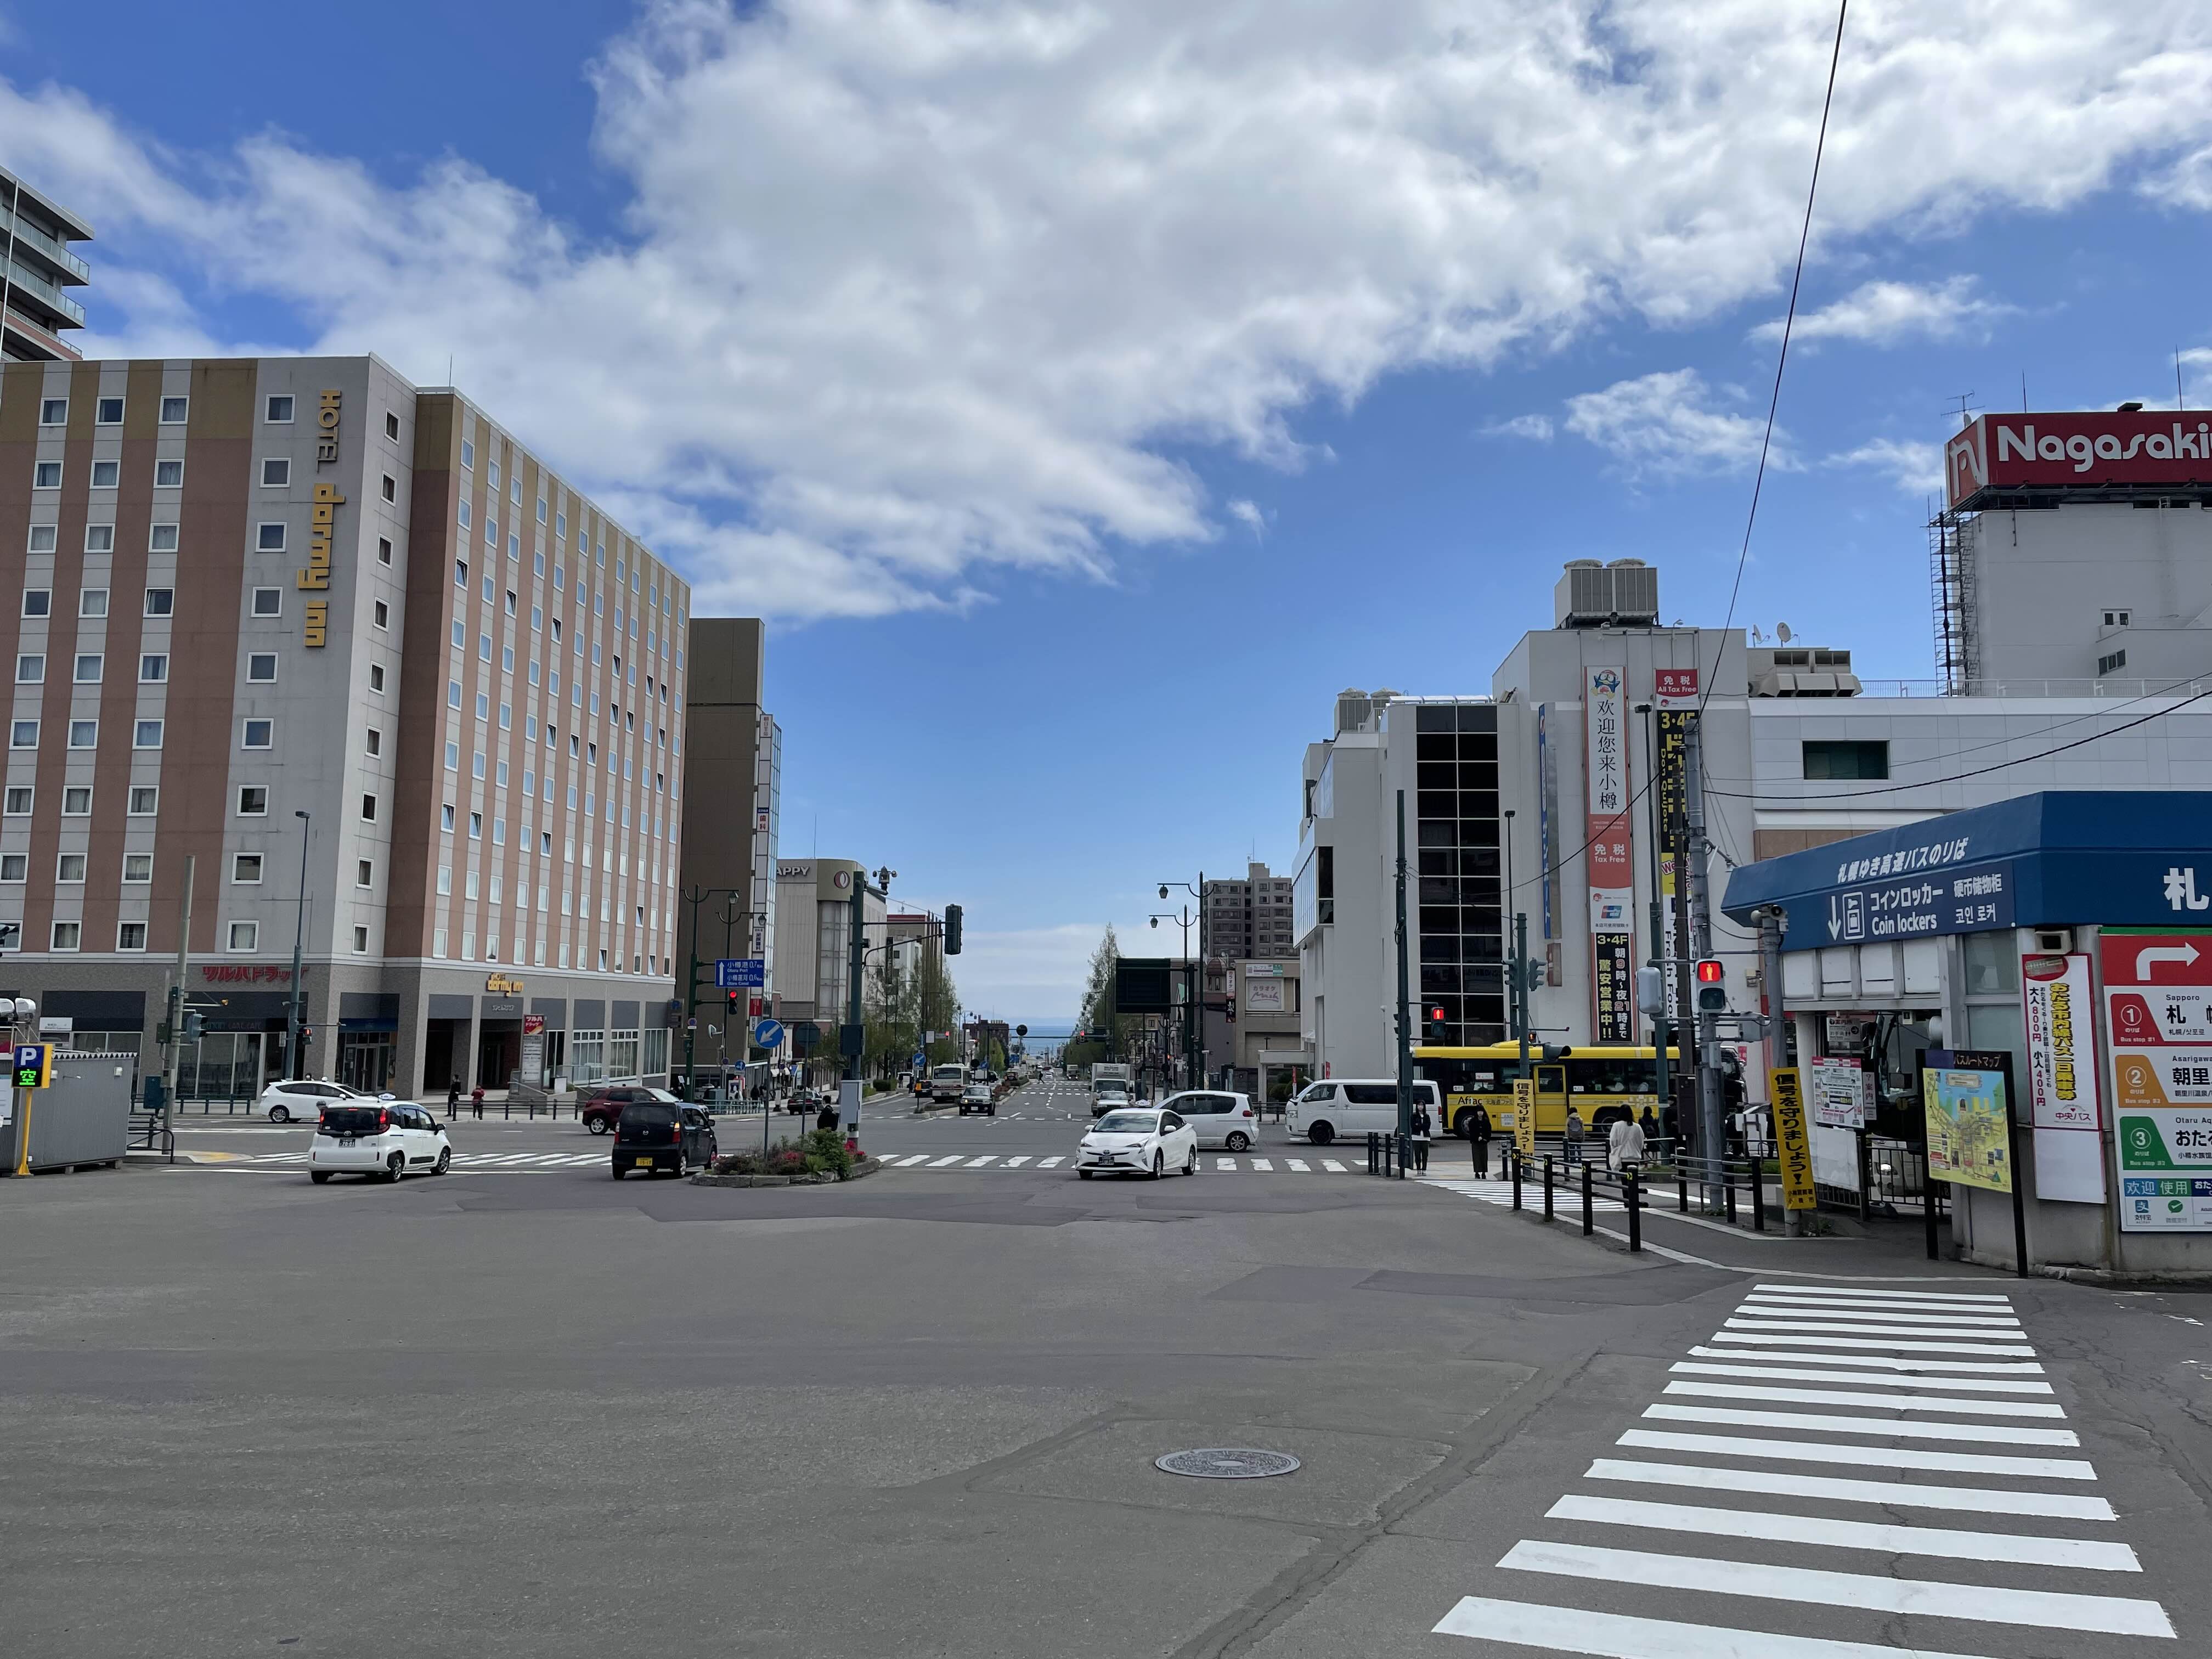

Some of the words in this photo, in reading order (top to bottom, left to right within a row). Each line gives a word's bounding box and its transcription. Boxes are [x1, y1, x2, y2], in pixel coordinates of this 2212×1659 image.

[317, 390, 341, 474] HOTEL
[1997, 422, 2212, 472] Nagasaki
[297, 483, 346, 590] dormy
[303, 600, 327, 647] inn
[1663, 675, 1690, 685] 免税
[1597, 699, 1617, 809] 欢迎您来小樽
[1594, 844, 1625, 855] 免税
[1838, 837, 1970, 883] 札幌ゆき高速バスのりば
[1870, 883, 1944, 911] コインロッカー
[2163, 867, 2210, 911] 札
[1871, 916, 1895, 935] Coin
[1897, 911, 1938, 934] lockers
[1955, 905, 1974, 924] 코인
[1977, 903, 1997, 922] 로커
[20, 1047, 37, 1065] P
[1953, 1053, 2001, 1068] バスルートマップ
[19, 1069, 36, 1086] 空
[2172, 1067, 2212, 1086] 朝里
[1458, 1096, 1482, 1105] Aflac
[2055, 1113, 2091, 1121] 中央バス
[2126, 1181, 2155, 1195] 欢迎
[2160, 1181, 2188, 1195] 使用
